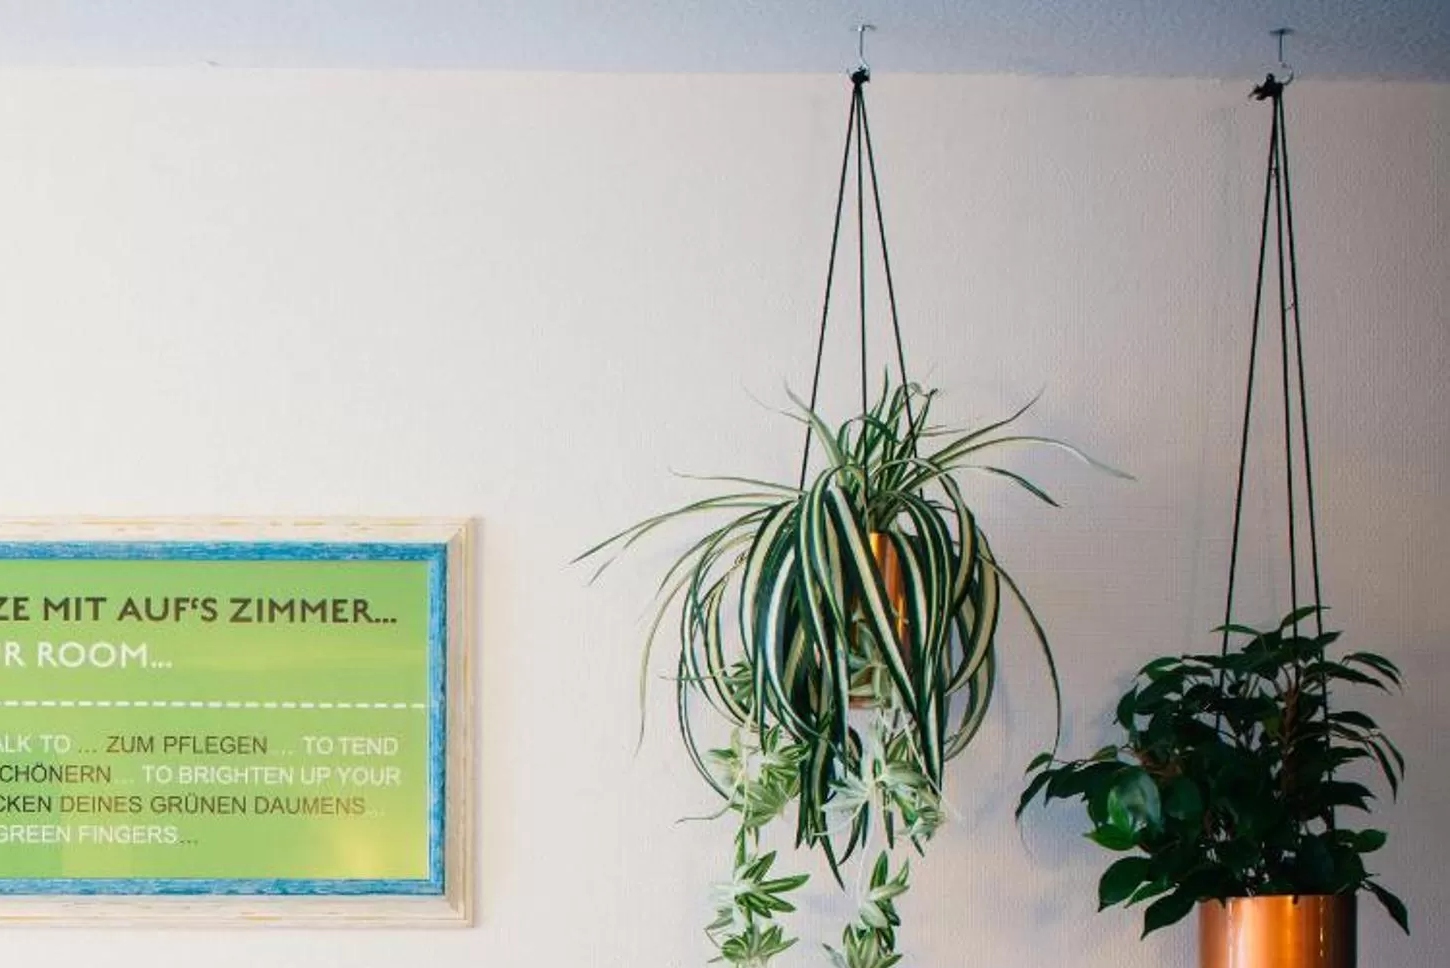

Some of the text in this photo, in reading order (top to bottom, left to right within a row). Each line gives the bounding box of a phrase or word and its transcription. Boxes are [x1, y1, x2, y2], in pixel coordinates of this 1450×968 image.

[43, 597, 107, 622] MIT
[229, 598, 398, 624] ZIMMER...
[40, 734, 72, 753] TO
[106, 735, 154, 755] ZUM
[302, 736, 333, 756] TO
[339, 736, 399, 756] TEND
[142, 765, 173, 785] TO
[178, 765, 294, 785] BRIGHTEN
[301, 766, 331, 786] UP
[337, 766, 401, 786] YOUR
[60, 795, 143, 815] DEINES
[150, 792, 247, 815] GRÜNEN
